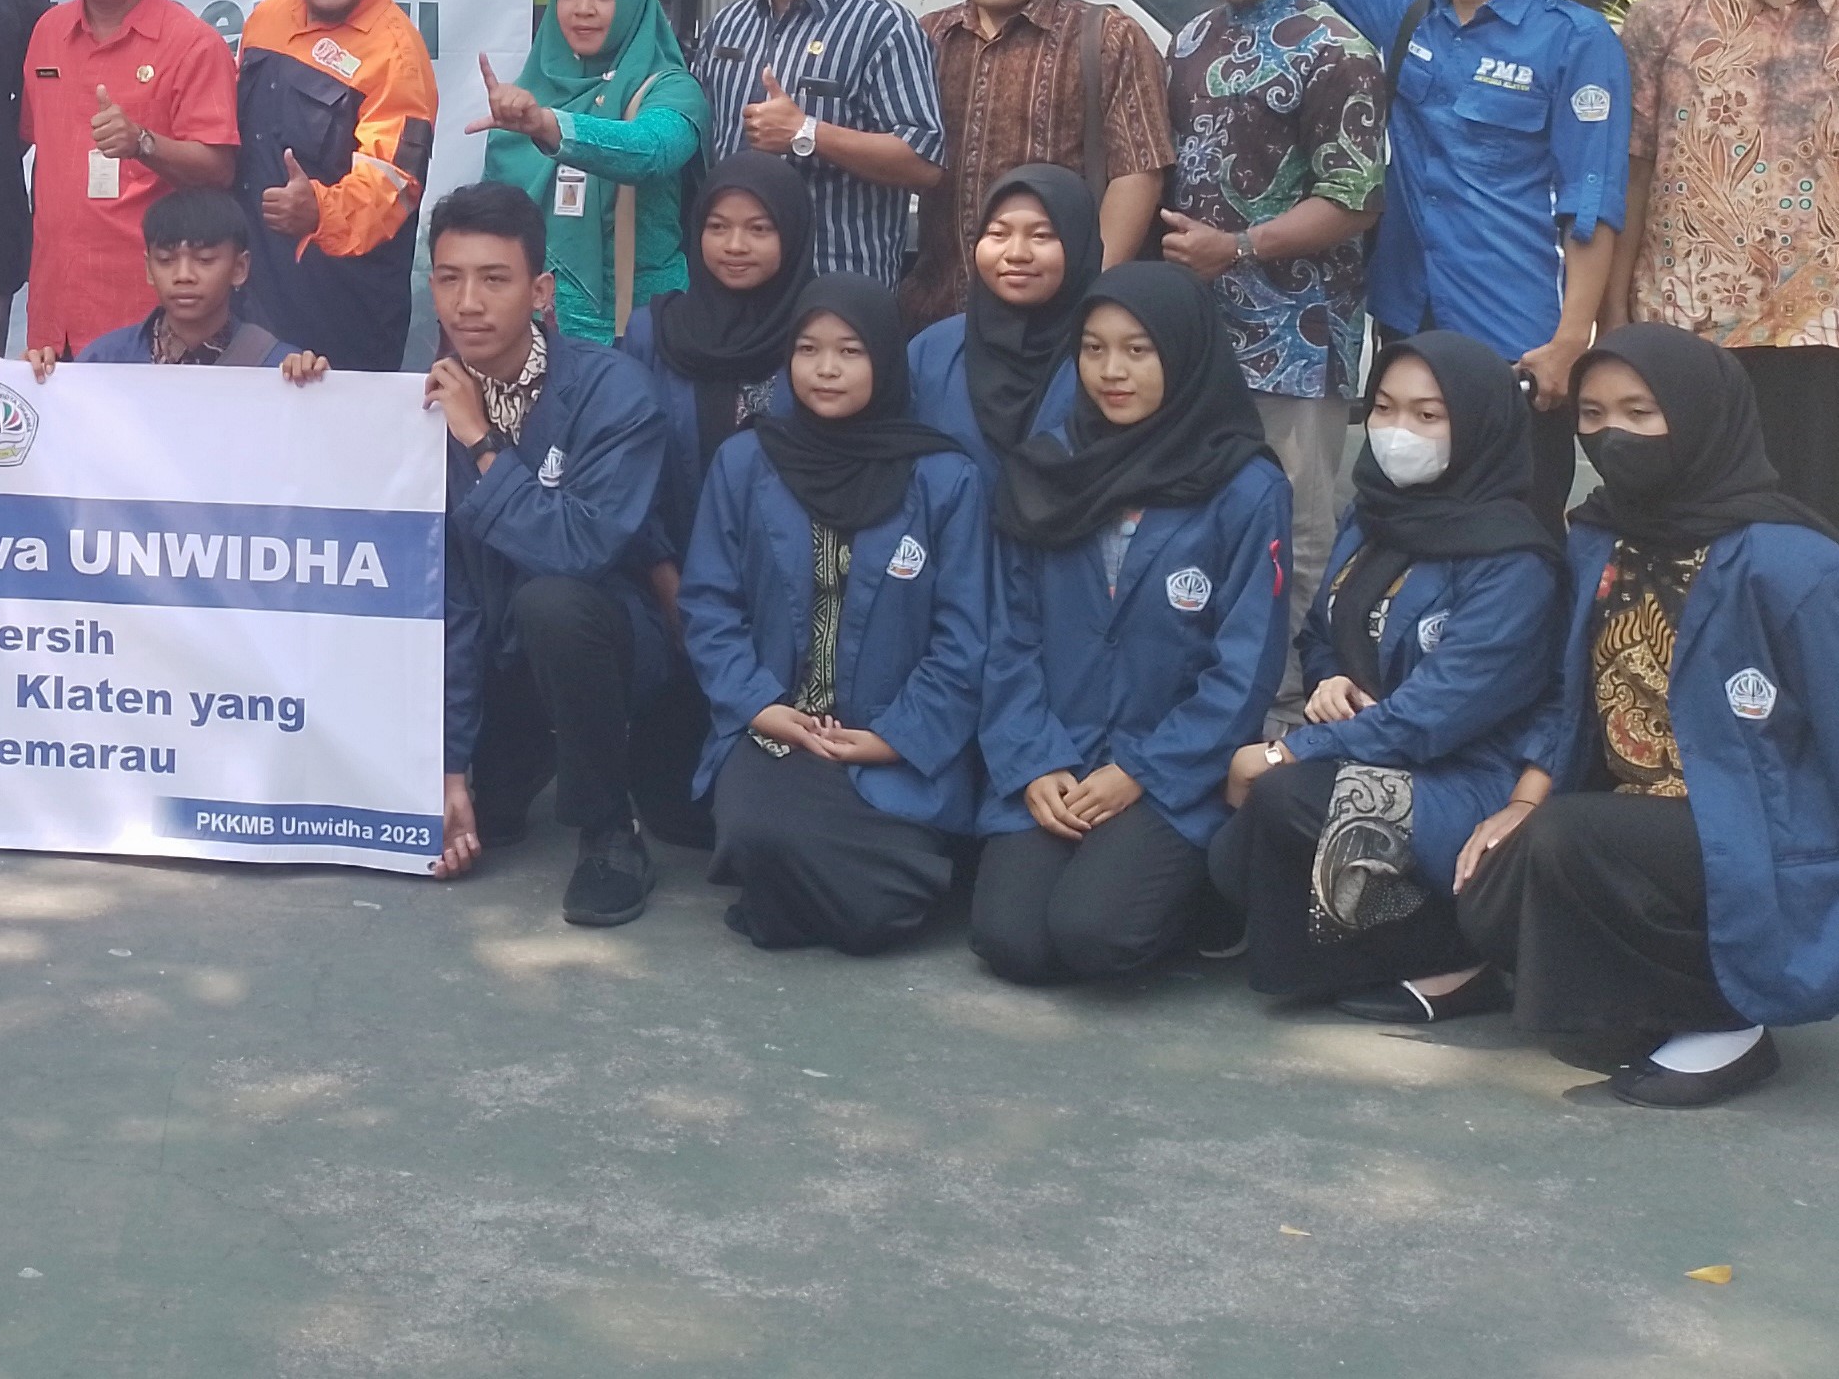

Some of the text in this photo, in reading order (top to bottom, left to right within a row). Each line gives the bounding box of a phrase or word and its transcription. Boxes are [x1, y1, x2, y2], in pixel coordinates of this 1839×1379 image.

[1475, 56, 1534, 85] PMB
[69, 528, 390, 588] UNWIDHA
[16, 673, 173, 715] Klaten
[189, 691, 307, 732] yang
[196, 811, 431, 847] PKKMB Unwidha 2023
